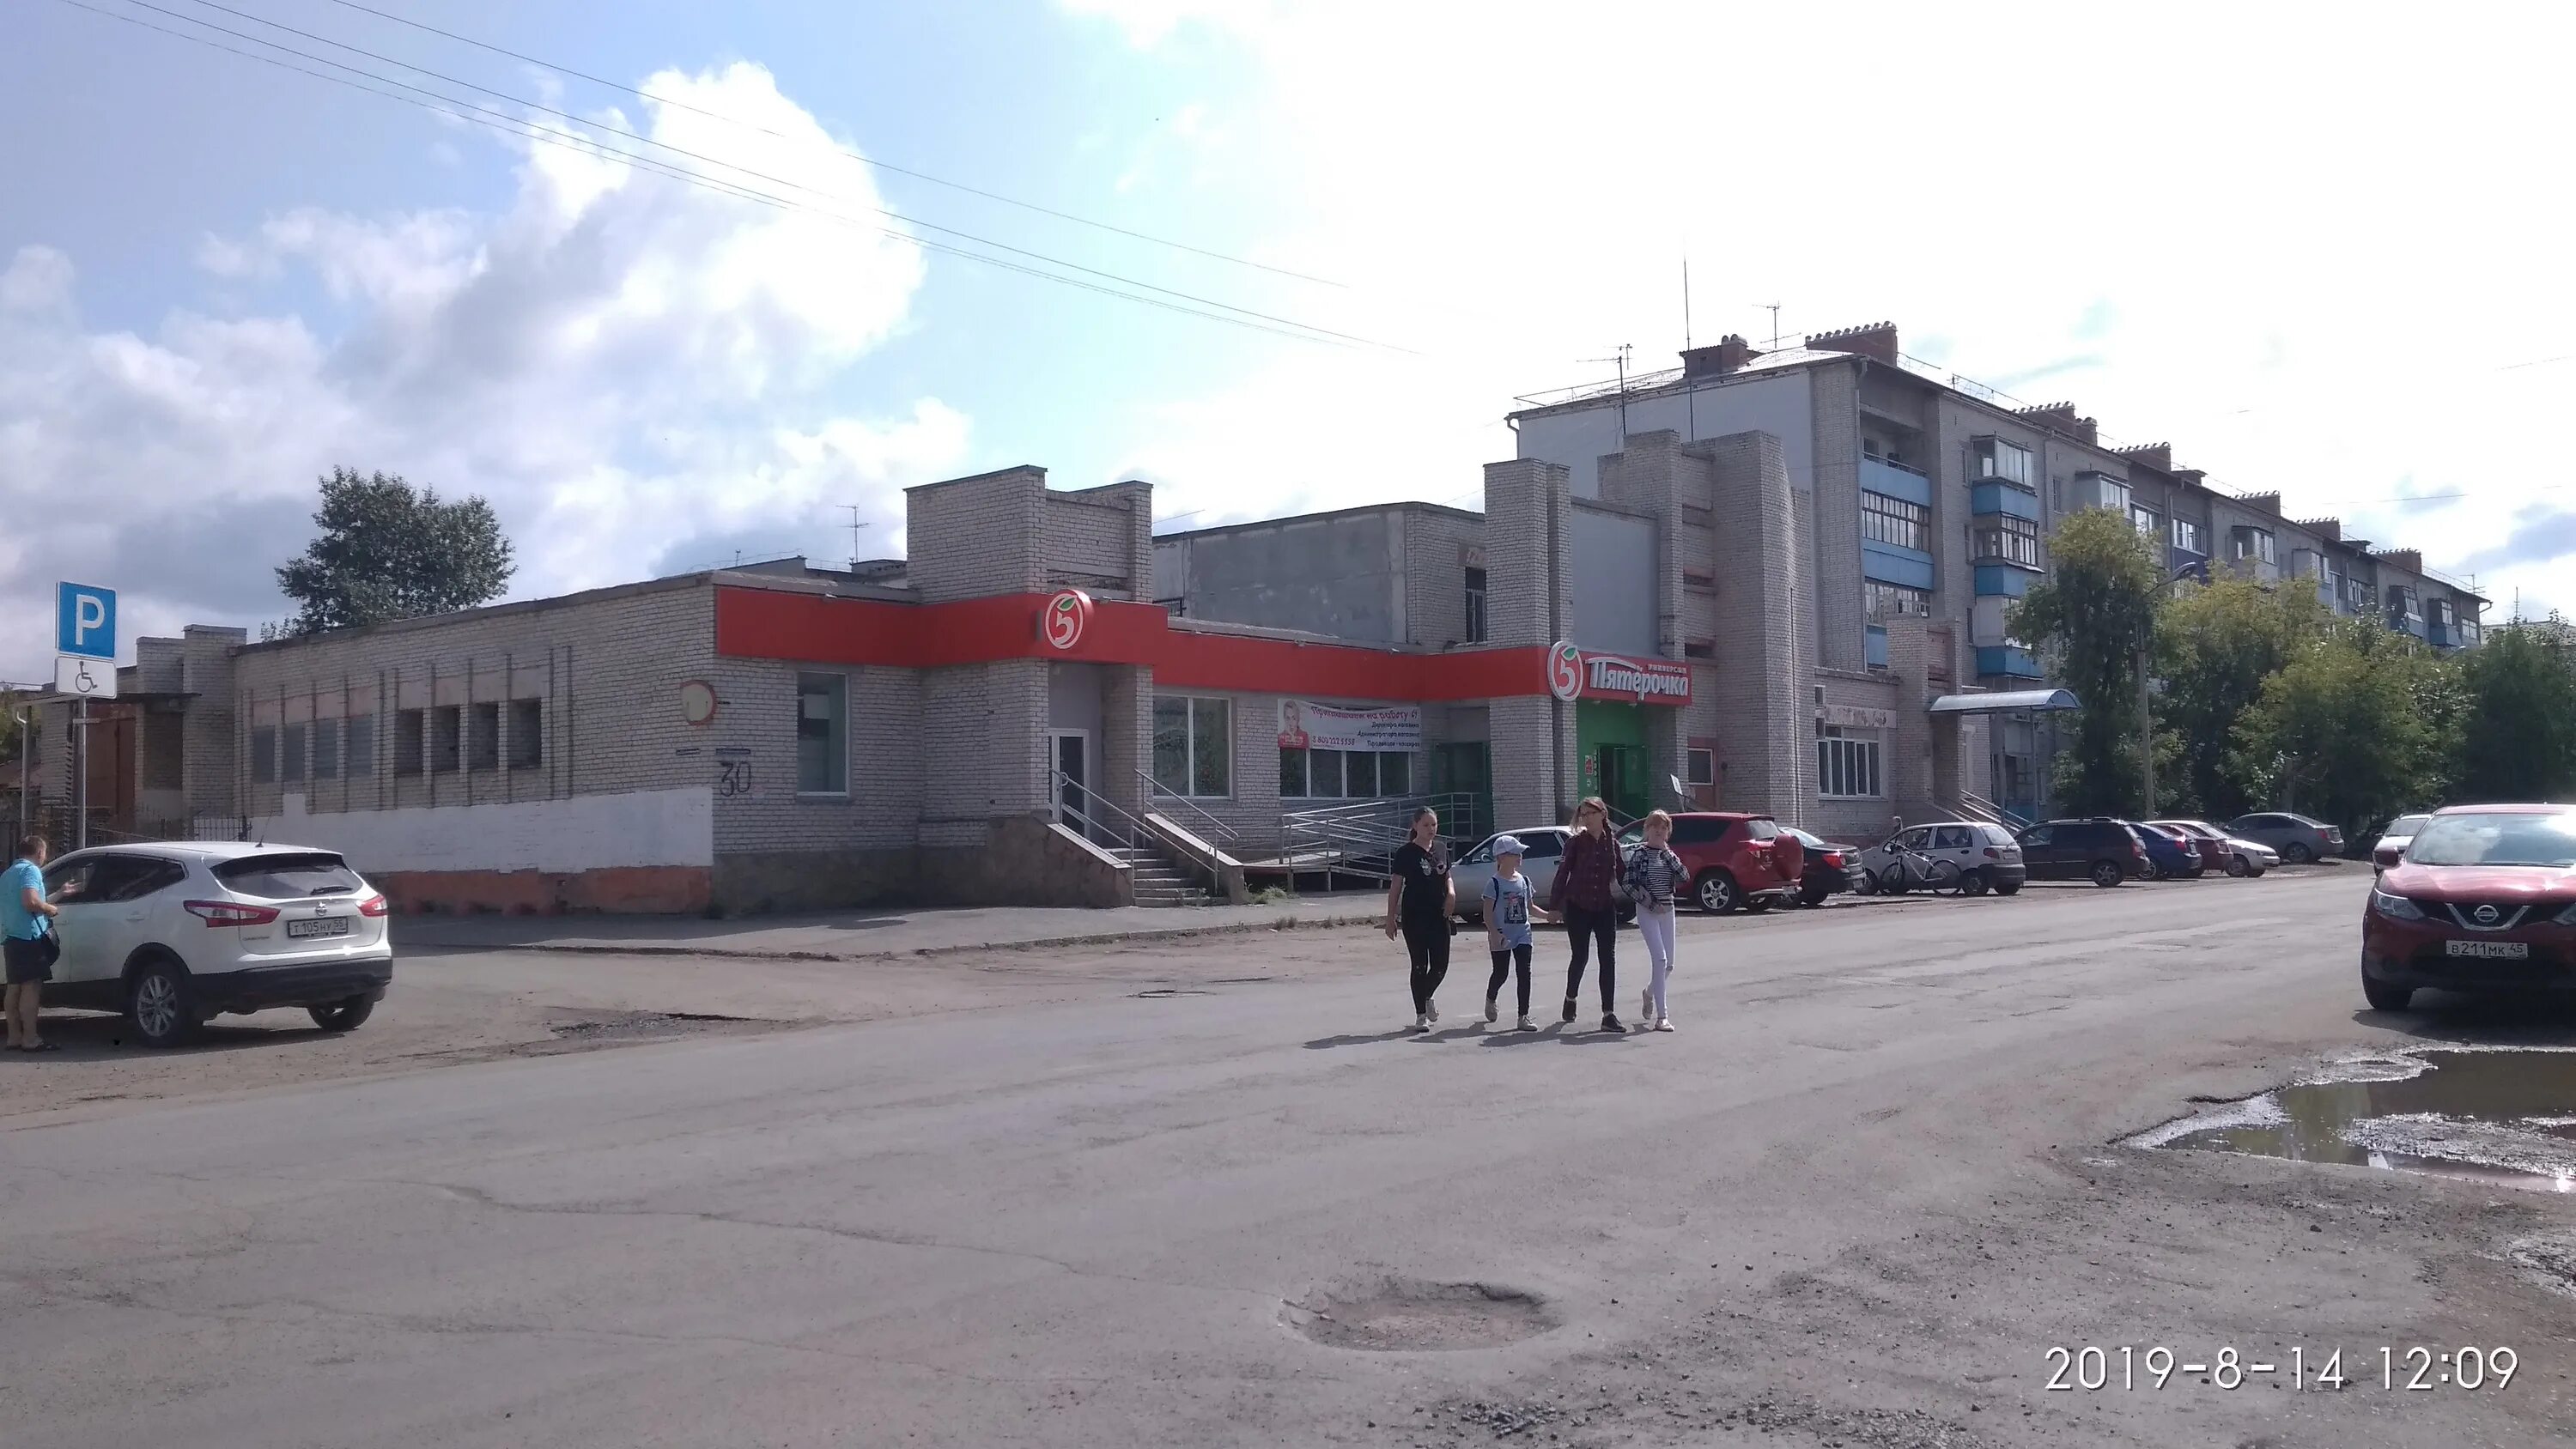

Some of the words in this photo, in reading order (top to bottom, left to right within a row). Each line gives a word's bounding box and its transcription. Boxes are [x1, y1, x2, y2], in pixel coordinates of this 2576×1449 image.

[76, 595, 105, 646] P
[1379, 710, 1409, 722] работу
[720, 761, 751, 797] 30
[2510, 944, 2523, 953] 45
